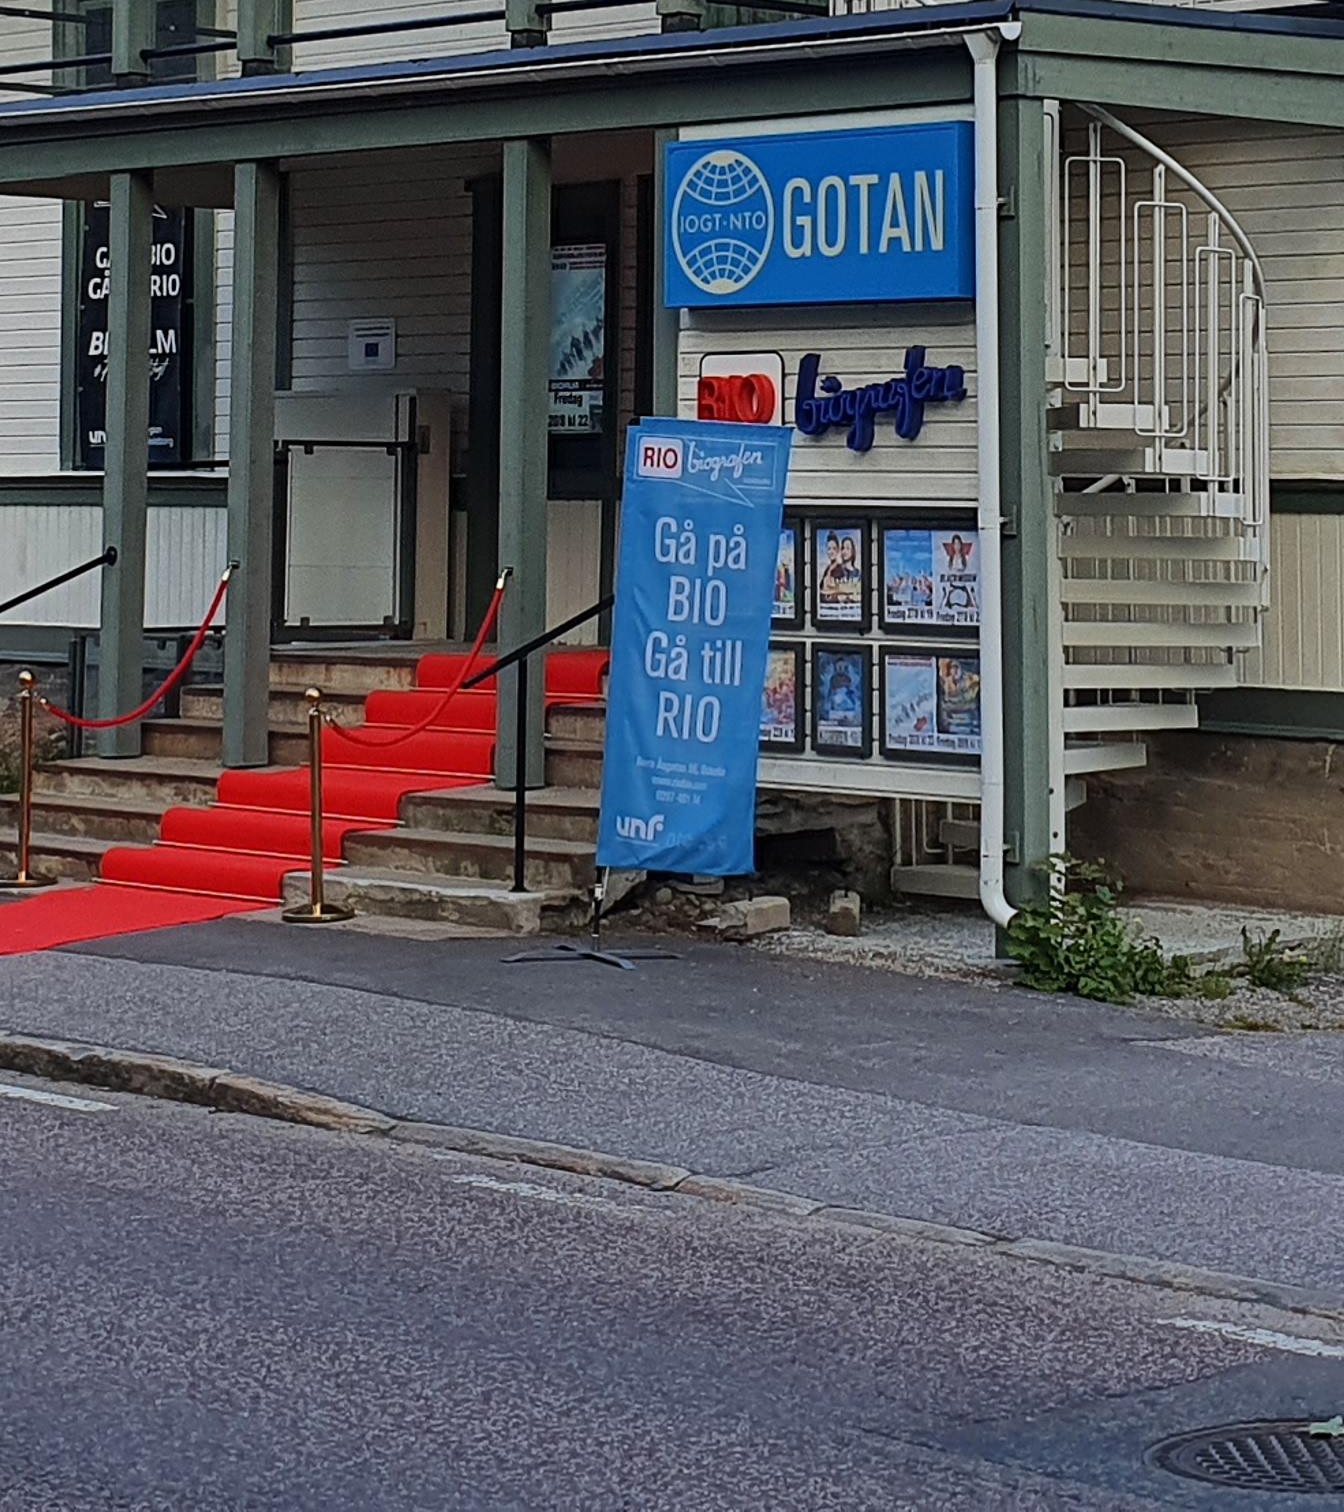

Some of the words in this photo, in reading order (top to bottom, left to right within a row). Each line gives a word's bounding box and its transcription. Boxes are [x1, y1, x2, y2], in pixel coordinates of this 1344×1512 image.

[782, 169, 945, 259] GOTAN
[150, 274, 180, 297] RIO
[643, 447, 678, 469] RIO
[687, 441, 764, 481] biografen
[655, 516, 696, 565] Gå
[707, 524, 747, 576] på
[667, 575, 727, 626] BIO
[645, 630, 688, 682] Gå
[701, 639, 743, 686] till
[657, 691, 721, 743] RIO
[616, 814, 665, 840] unf
